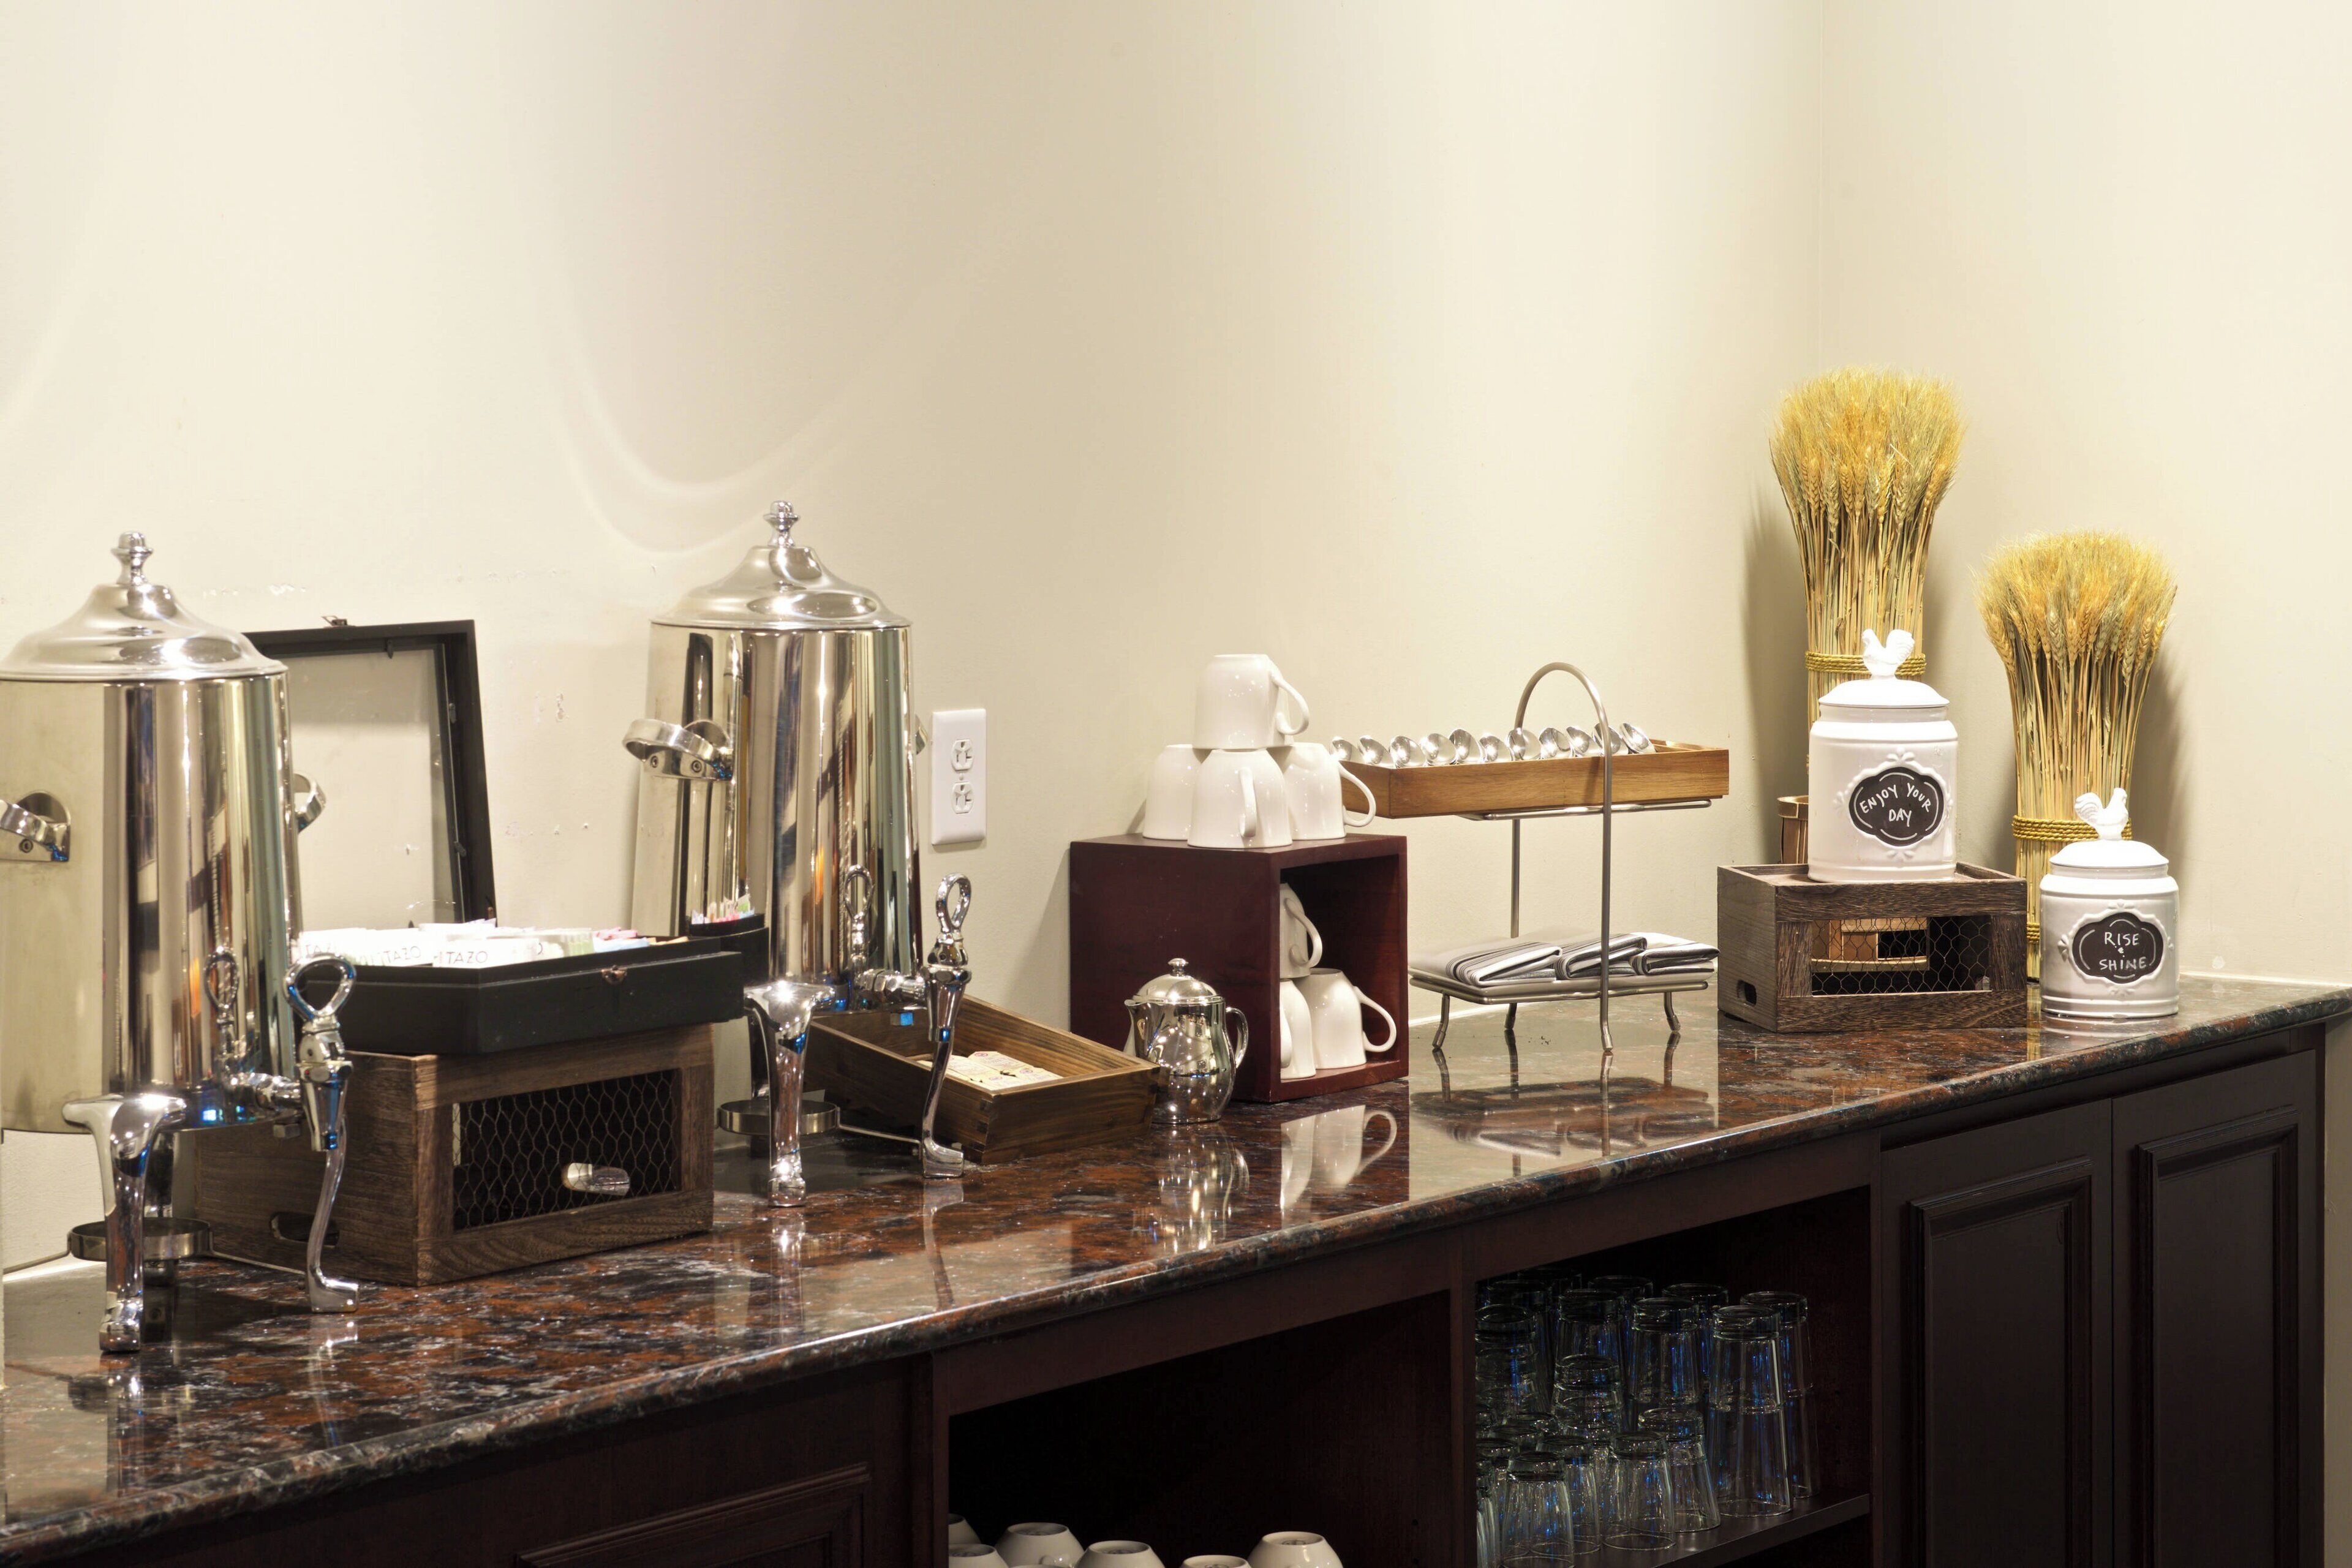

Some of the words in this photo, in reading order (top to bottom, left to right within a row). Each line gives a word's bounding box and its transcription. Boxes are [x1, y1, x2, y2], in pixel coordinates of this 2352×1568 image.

[1860, 785, 1898, 813] ENJOY
[1907, 782, 1932, 812] YOUR
[1889, 808, 1912, 827] DAY
[2105, 932, 2139, 946] RISE
[384, 946, 421, 963] TAZO
[446, 951, 488, 964] TAZO
[2099, 957, 2147, 971] SHINE
